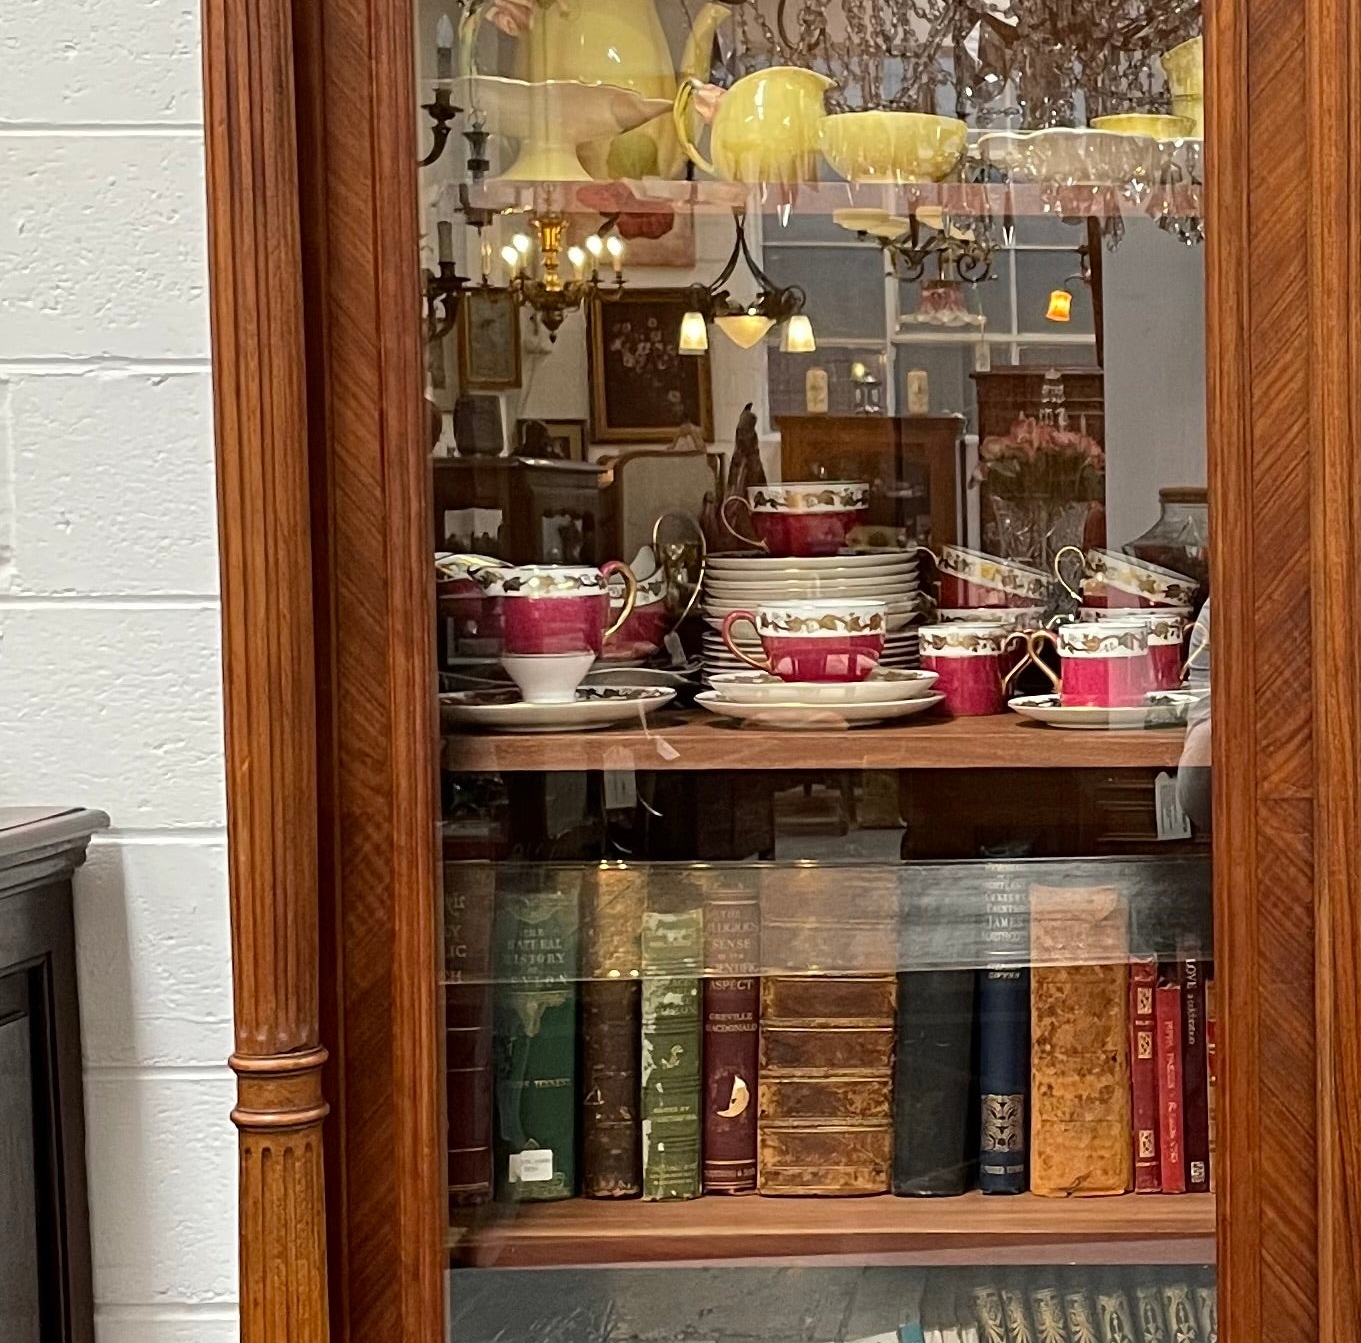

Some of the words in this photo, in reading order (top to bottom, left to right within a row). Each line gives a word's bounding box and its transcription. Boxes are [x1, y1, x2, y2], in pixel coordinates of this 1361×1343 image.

[987, 915, 1025, 930] JAMES
[712, 938, 752, 950] SENSE
[1185, 958, 1198, 989] LOVE
[709, 979, 754, 991] ASPECT
